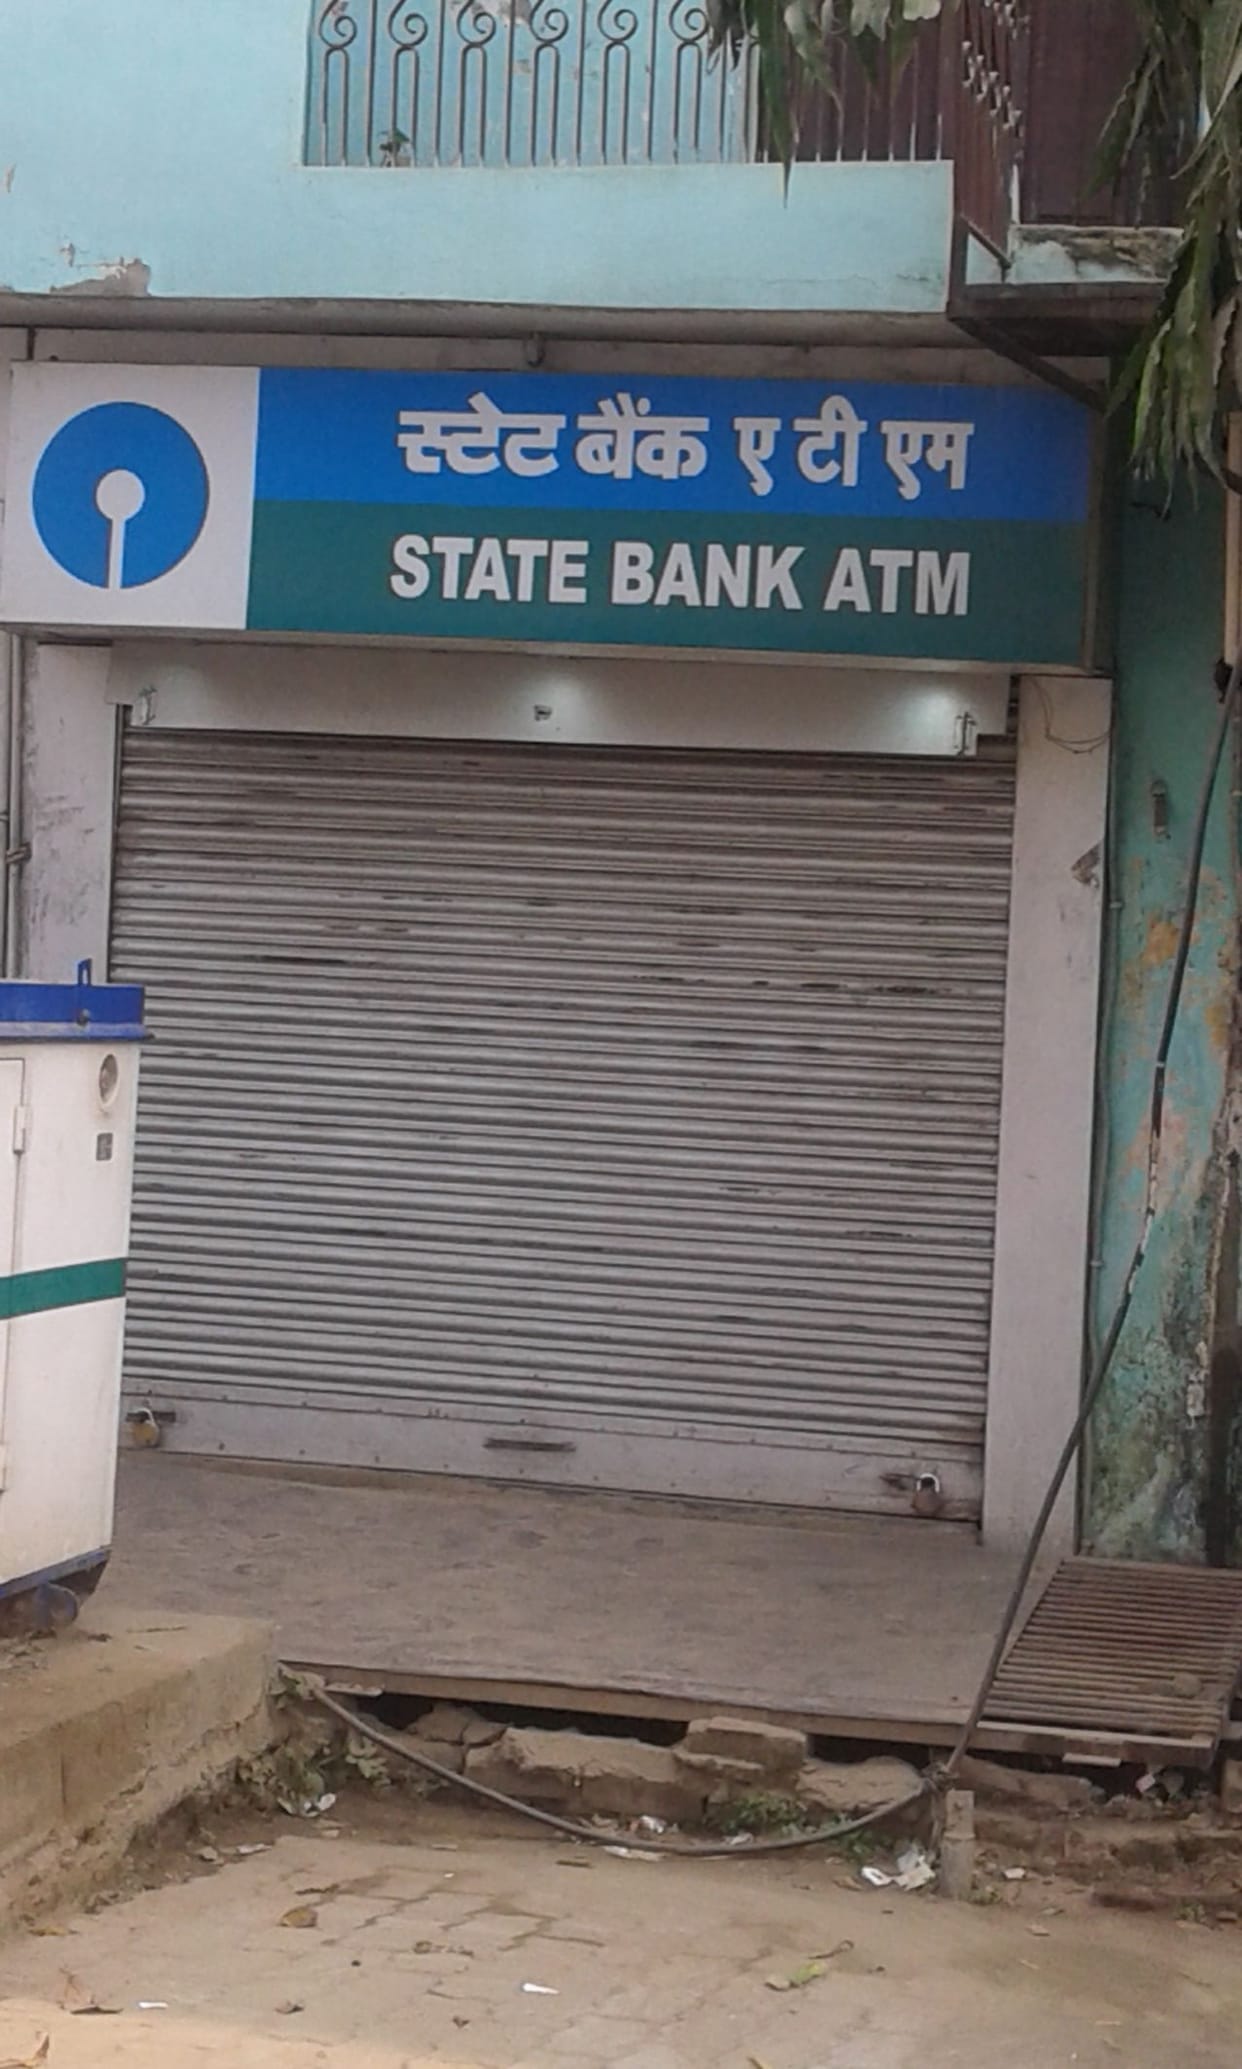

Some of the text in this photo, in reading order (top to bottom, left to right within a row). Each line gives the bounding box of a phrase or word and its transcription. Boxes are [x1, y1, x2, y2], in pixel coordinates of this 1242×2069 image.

[397, 391, 975, 501] स्टेट बैंक ए टी एम
[389, 534, 971, 616] STATE BANK ATM
